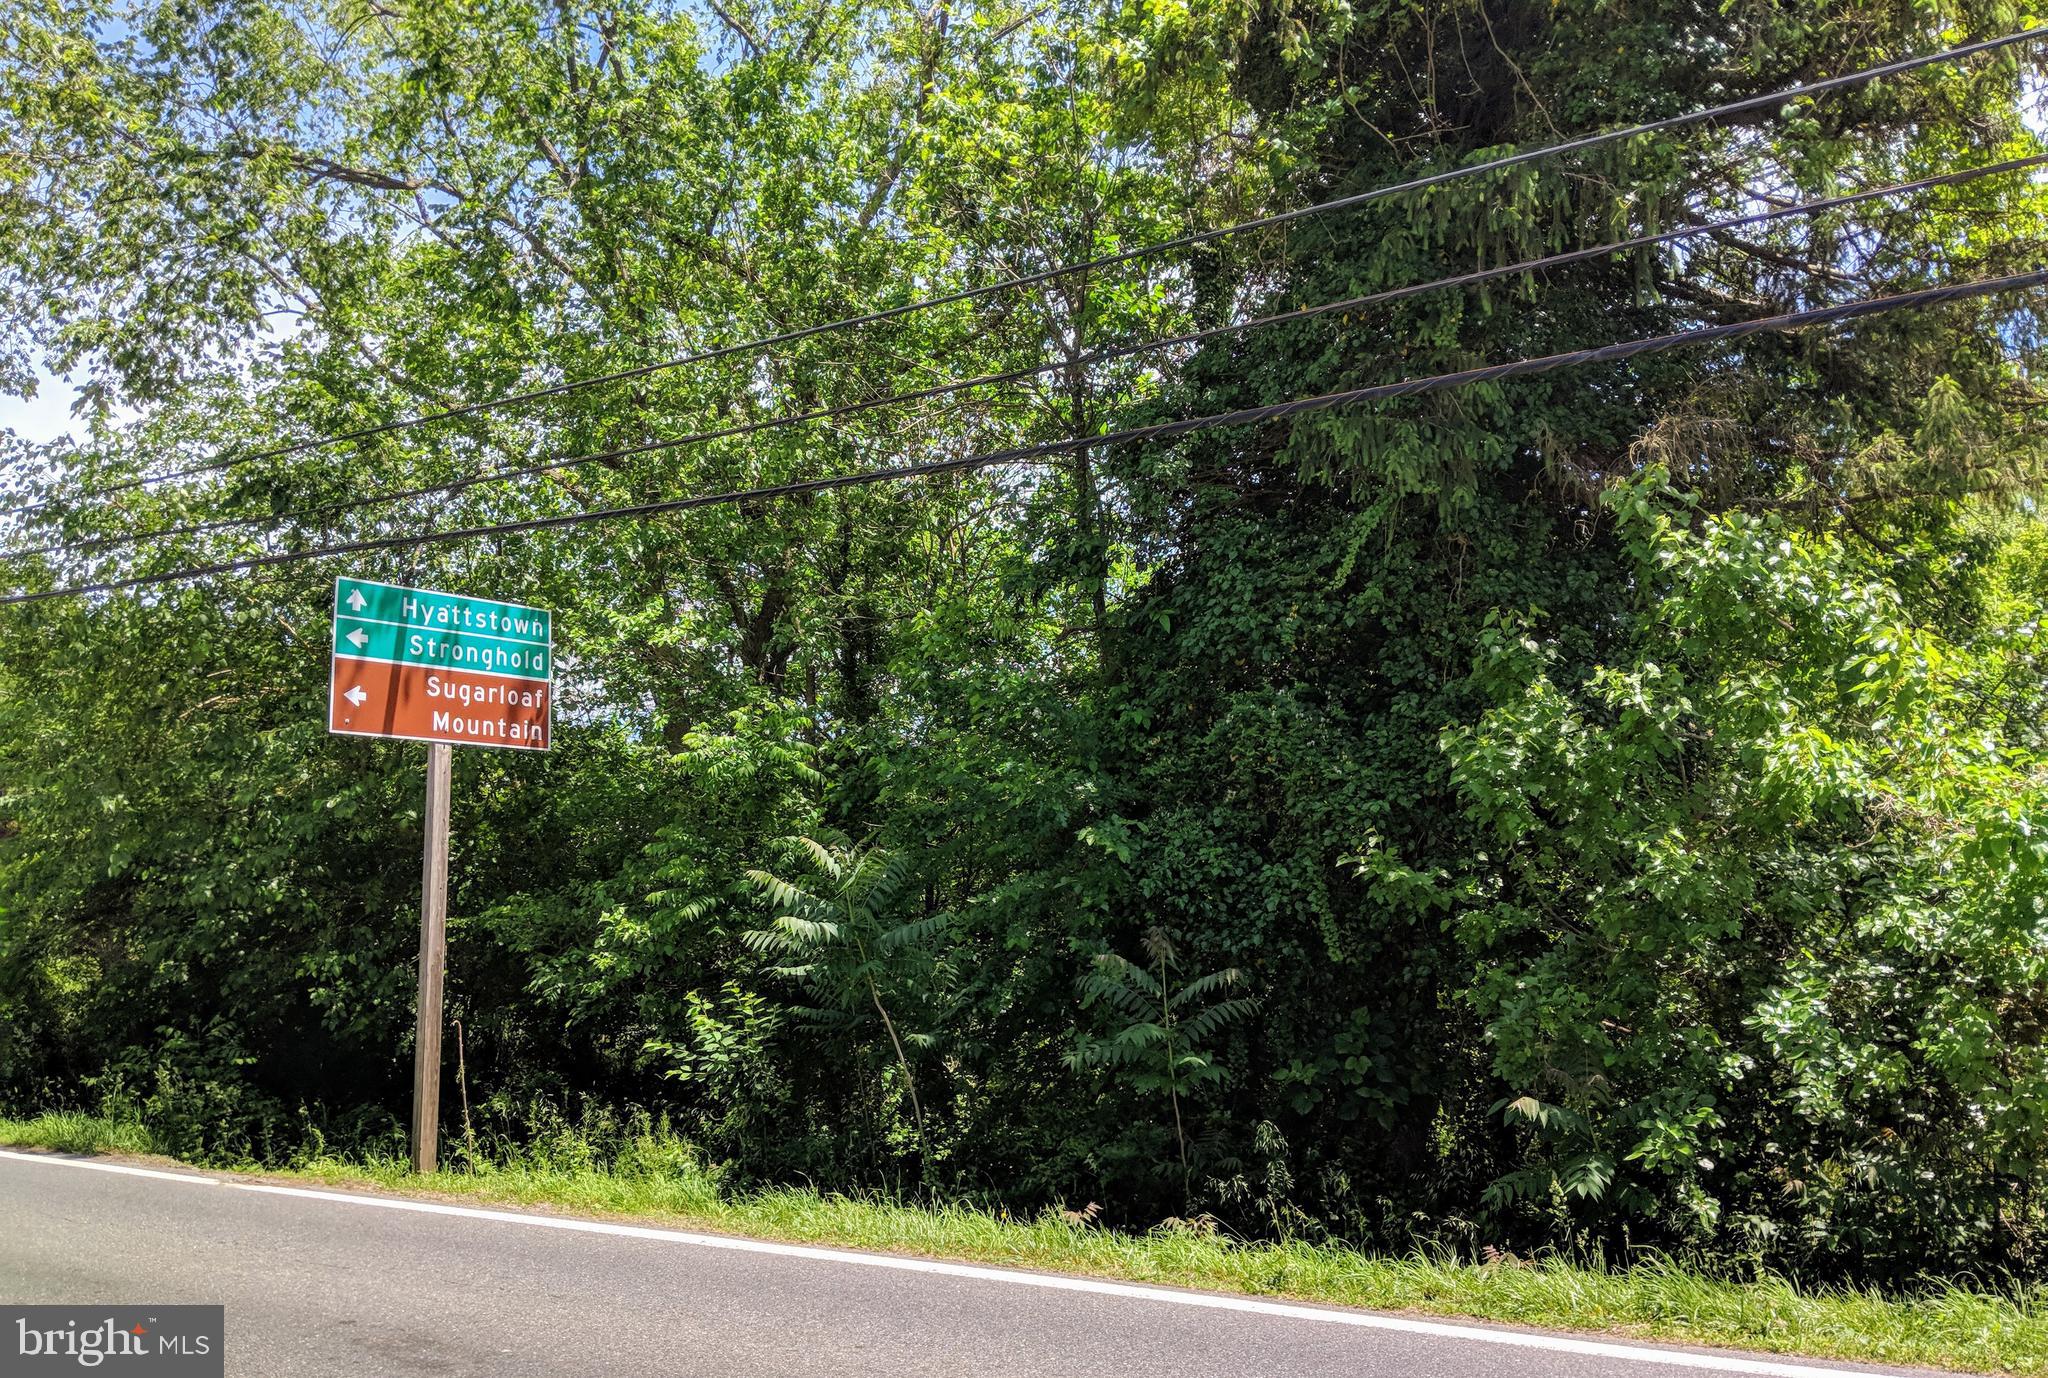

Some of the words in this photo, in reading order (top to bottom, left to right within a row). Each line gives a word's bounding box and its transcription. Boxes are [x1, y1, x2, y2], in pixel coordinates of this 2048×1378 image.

[402, 597, 543, 637] Hyattstown
[410, 635, 543, 671] Stronghold
[427, 676, 543, 708] Sugarloaf
[433, 711, 542, 741] Mountain
